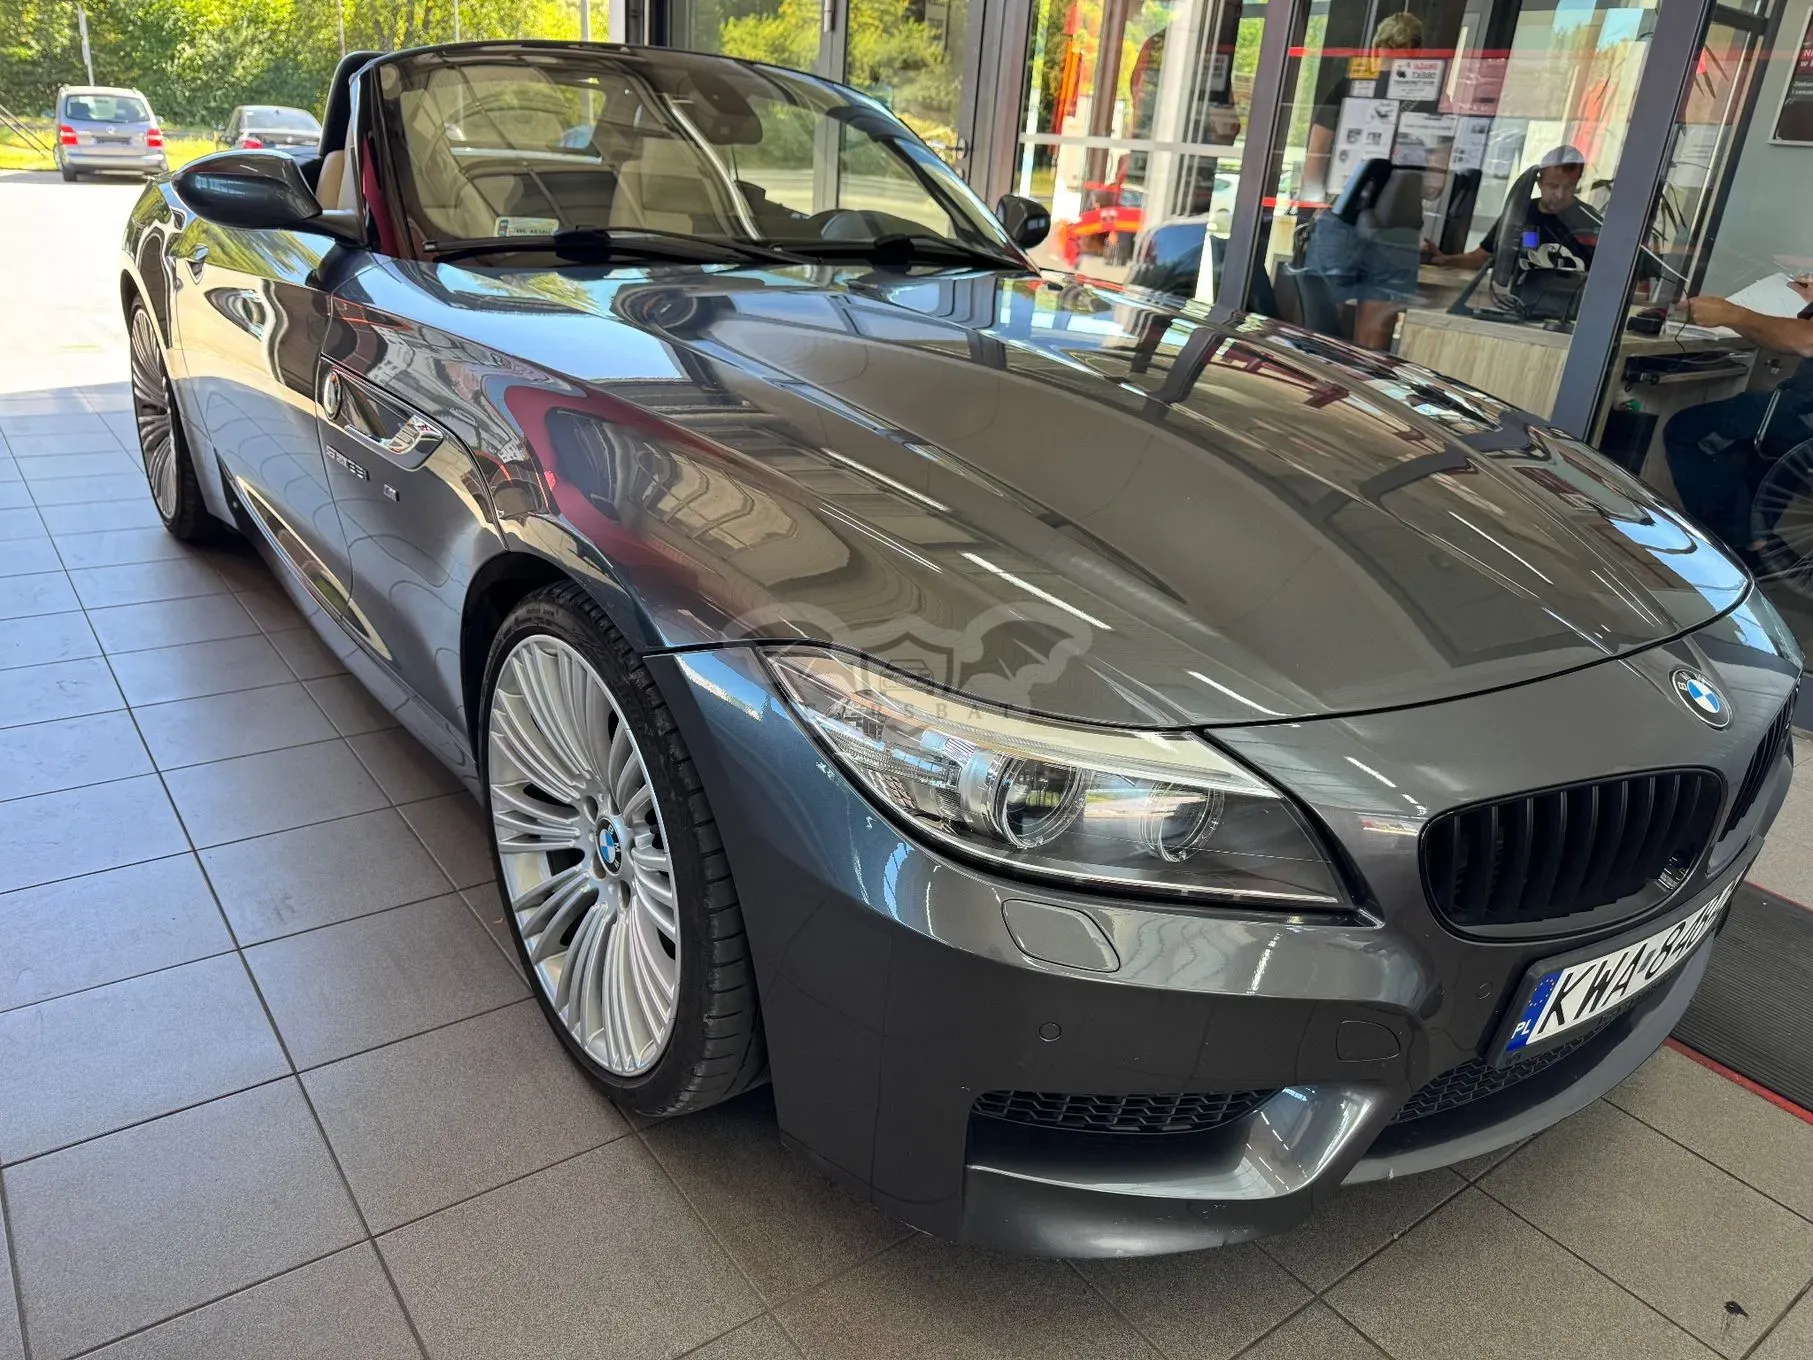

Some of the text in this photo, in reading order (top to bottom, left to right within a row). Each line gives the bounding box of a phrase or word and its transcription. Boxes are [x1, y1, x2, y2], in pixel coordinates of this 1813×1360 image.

[607, 824, 621, 870] BMW
[1537, 942, 1649, 1035] KWA
[1510, 1018, 1532, 1040] PL
